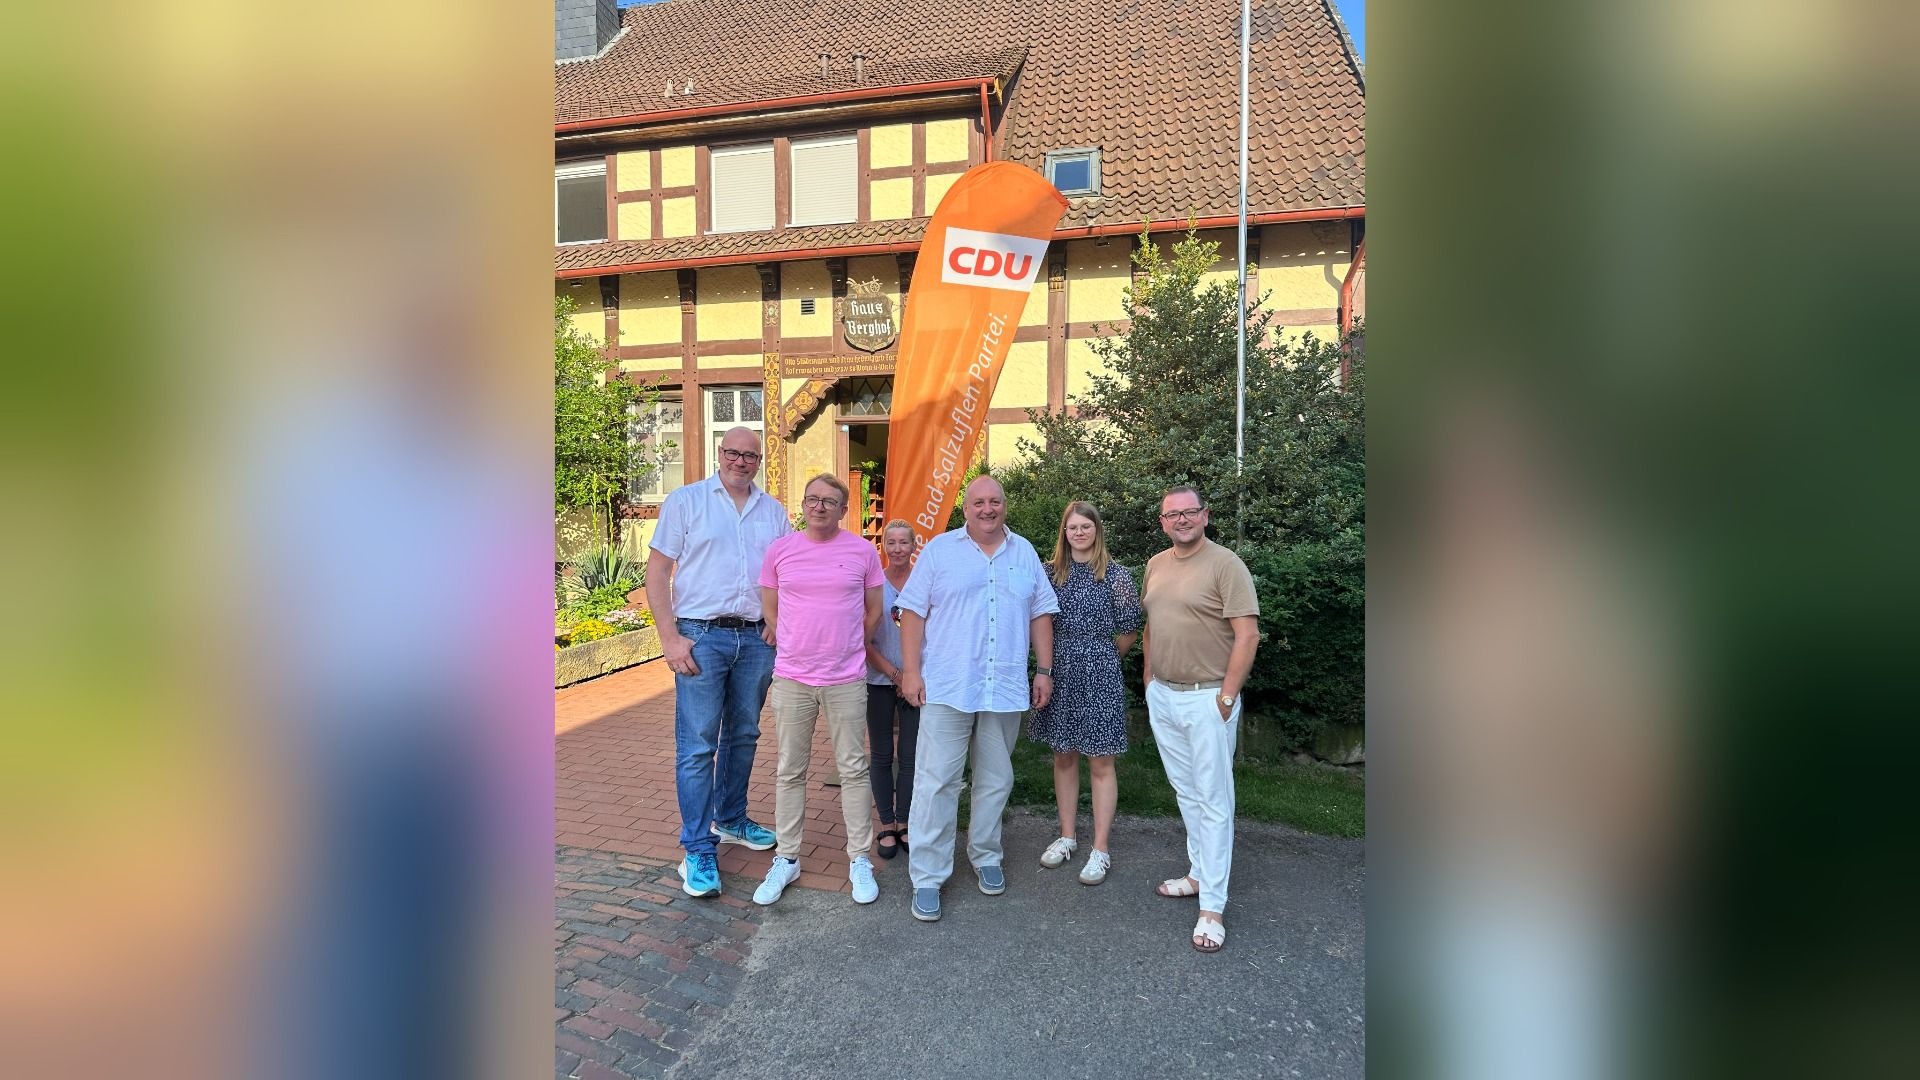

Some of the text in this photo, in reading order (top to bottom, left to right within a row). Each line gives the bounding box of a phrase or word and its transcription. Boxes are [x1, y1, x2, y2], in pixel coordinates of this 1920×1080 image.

[948, 246, 1032, 280] CDU
[846, 318, 891, 337] Berghof
[916, 484, 945, 530] Bad
[932, 386, 981, 485] Salzuflen
[968, 312, 1008, 382] Partei.
